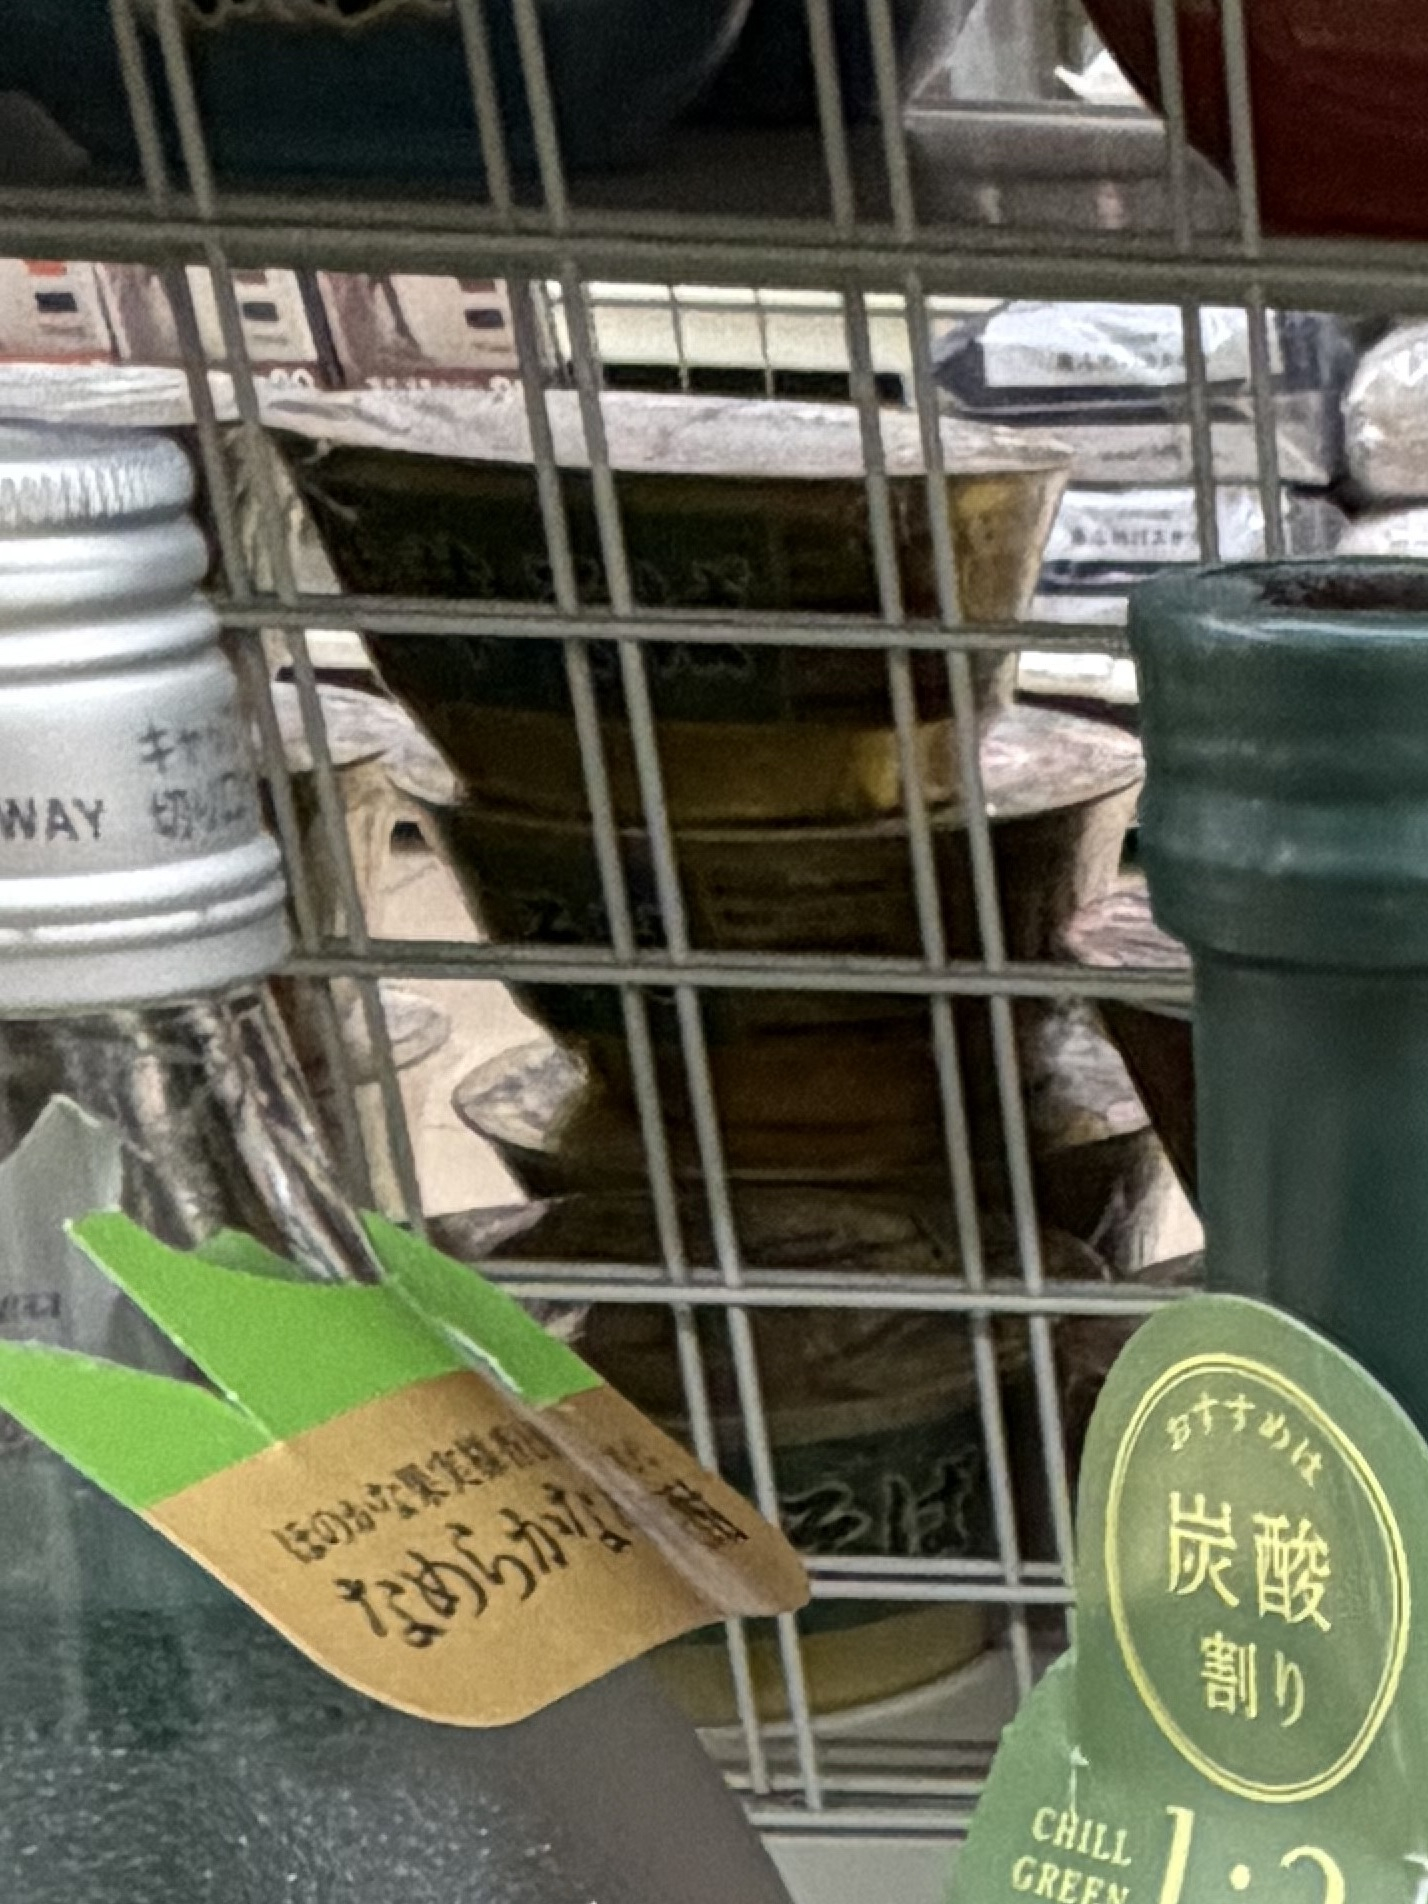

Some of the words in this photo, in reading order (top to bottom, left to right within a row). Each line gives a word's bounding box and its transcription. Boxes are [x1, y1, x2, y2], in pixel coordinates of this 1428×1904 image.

[1163, 1390, 1322, 1488] おすすめは
[1165, 1489, 1334, 1633] 炭酸
[1200, 1632, 1307, 1728] 割り
[1031, 1805, 1133, 1867] CHILL
